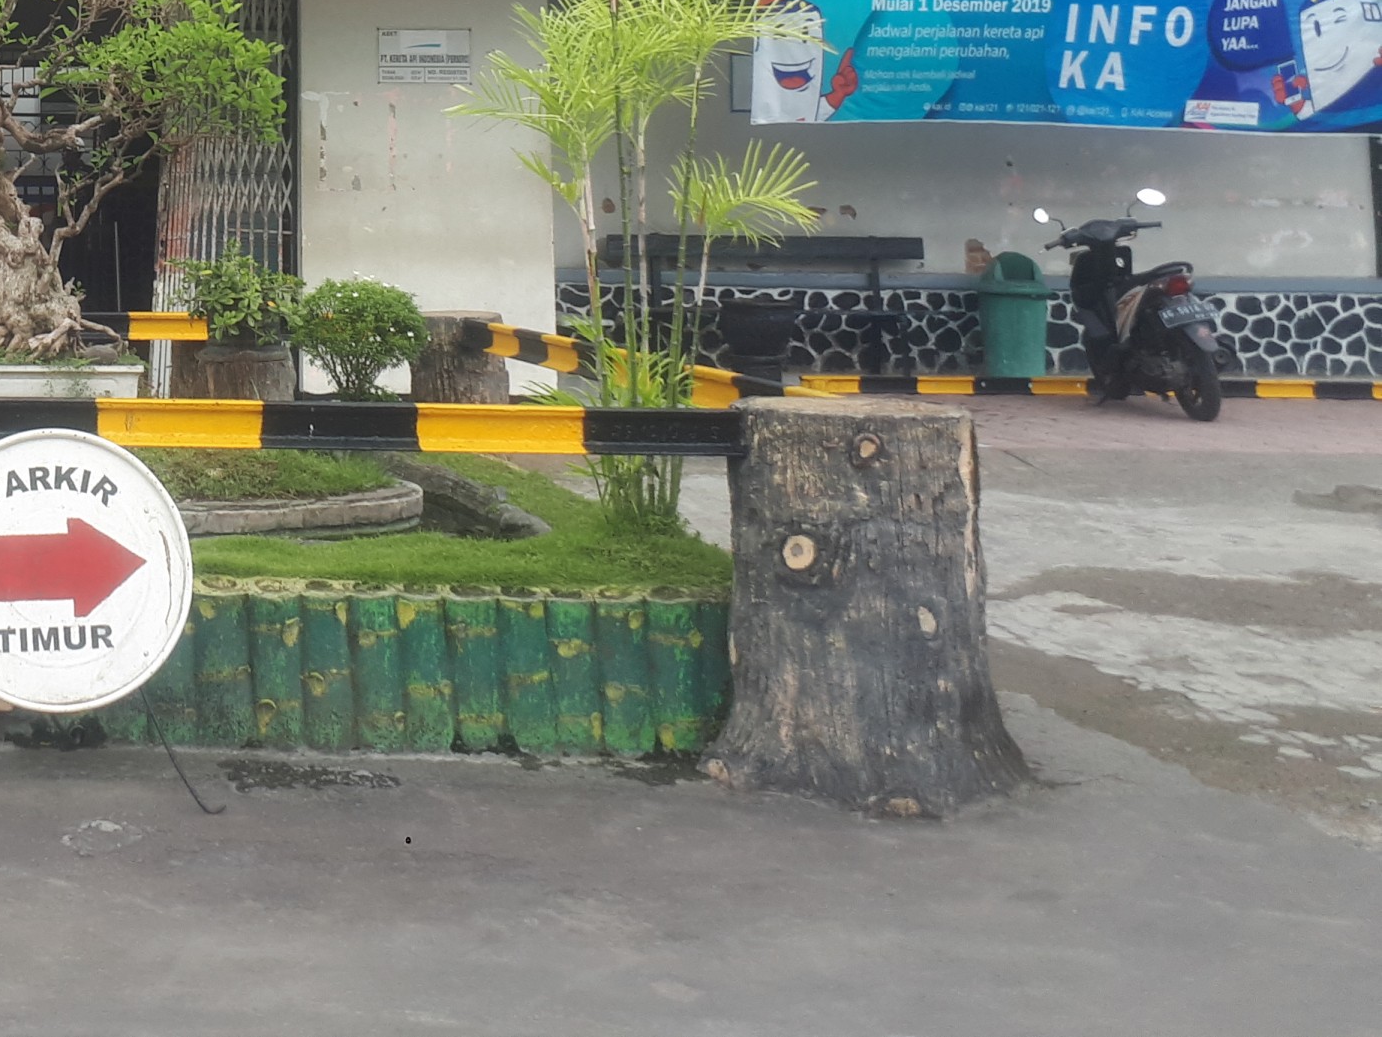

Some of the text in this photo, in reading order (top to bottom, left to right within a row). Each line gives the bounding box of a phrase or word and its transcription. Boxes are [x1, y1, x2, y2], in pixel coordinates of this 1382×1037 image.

[1065, 3, 1194, 47] INFO
[1223, 16, 1259, 31] LUPA
[868, 24, 1044, 41] Jadwal perjalanan kereta api
[867, 43, 1010, 60] mengalami perubahan,
[1058, 50, 1126, 91] KA
